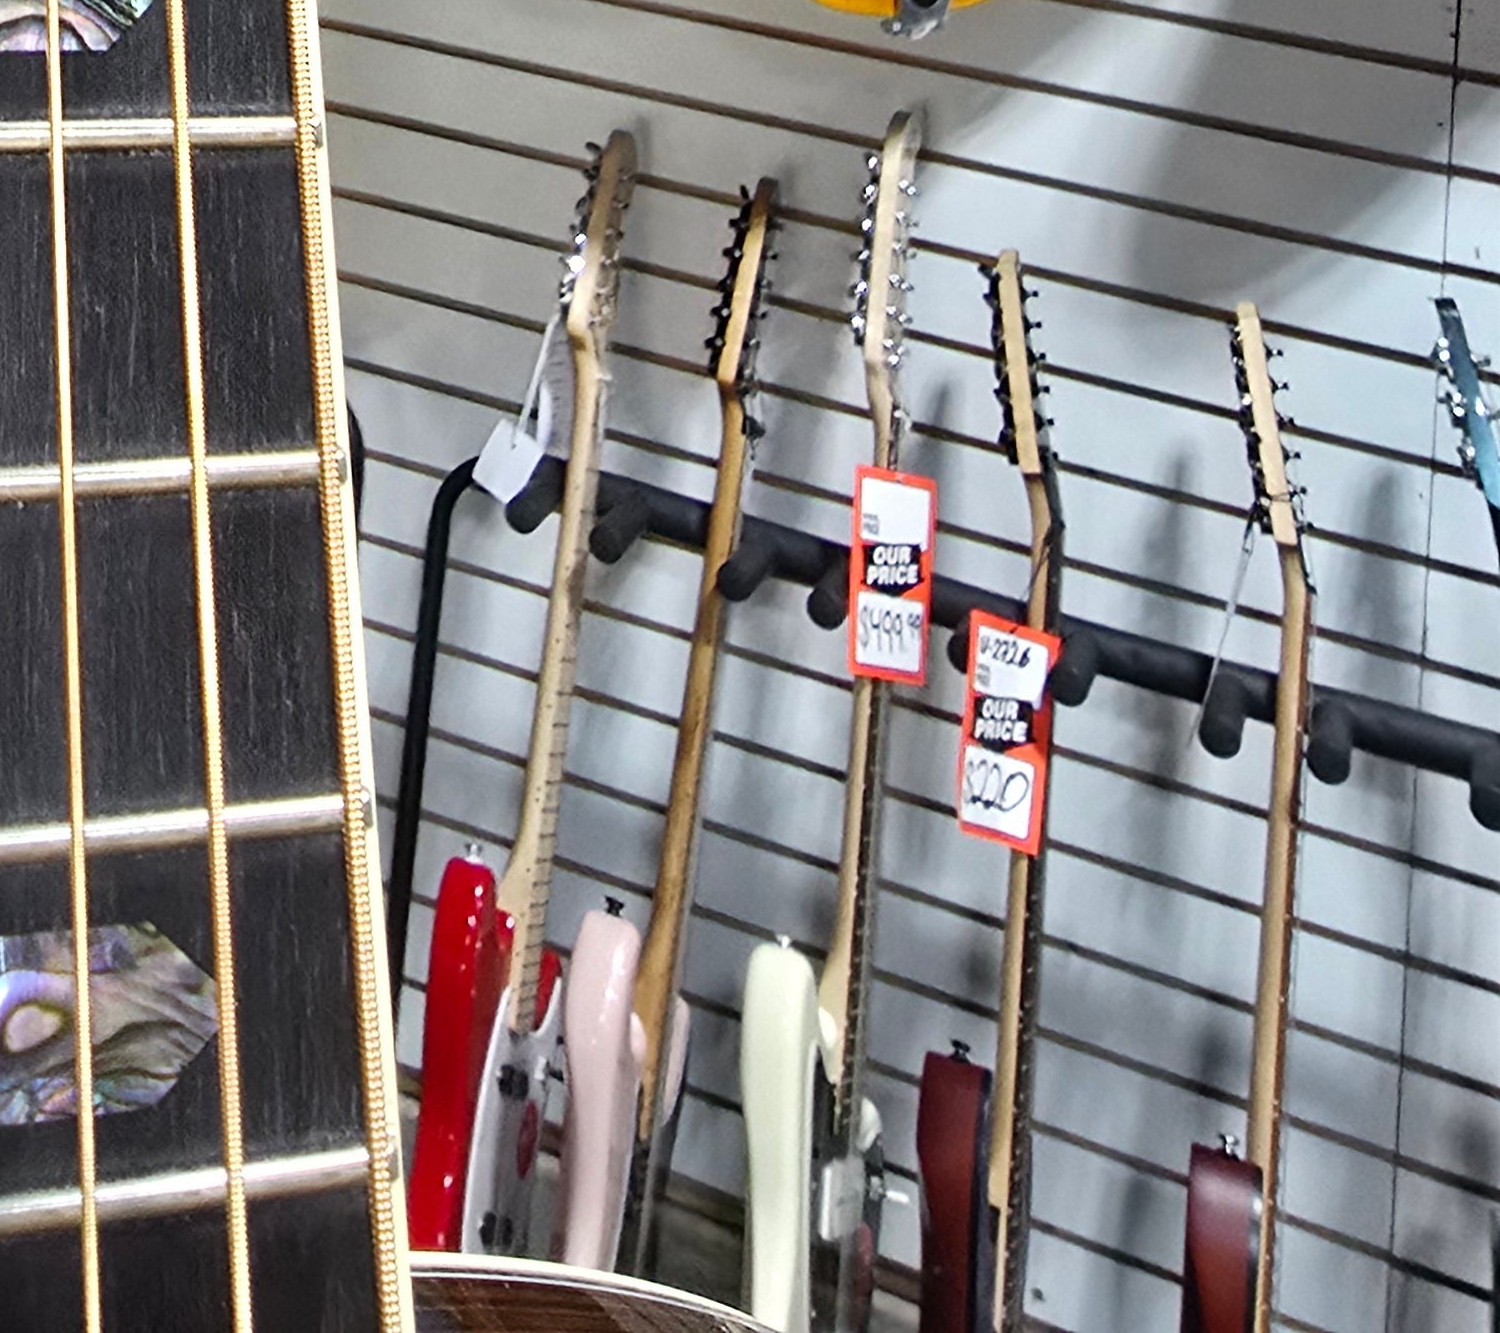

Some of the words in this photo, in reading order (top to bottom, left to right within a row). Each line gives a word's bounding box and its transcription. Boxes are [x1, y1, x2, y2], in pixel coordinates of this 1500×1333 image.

[872, 546, 912, 565] OUR
[866, 563, 918, 585] PRICE
[982, 699, 1019, 720] OUR
[974, 718, 1028, 742] PRICE
